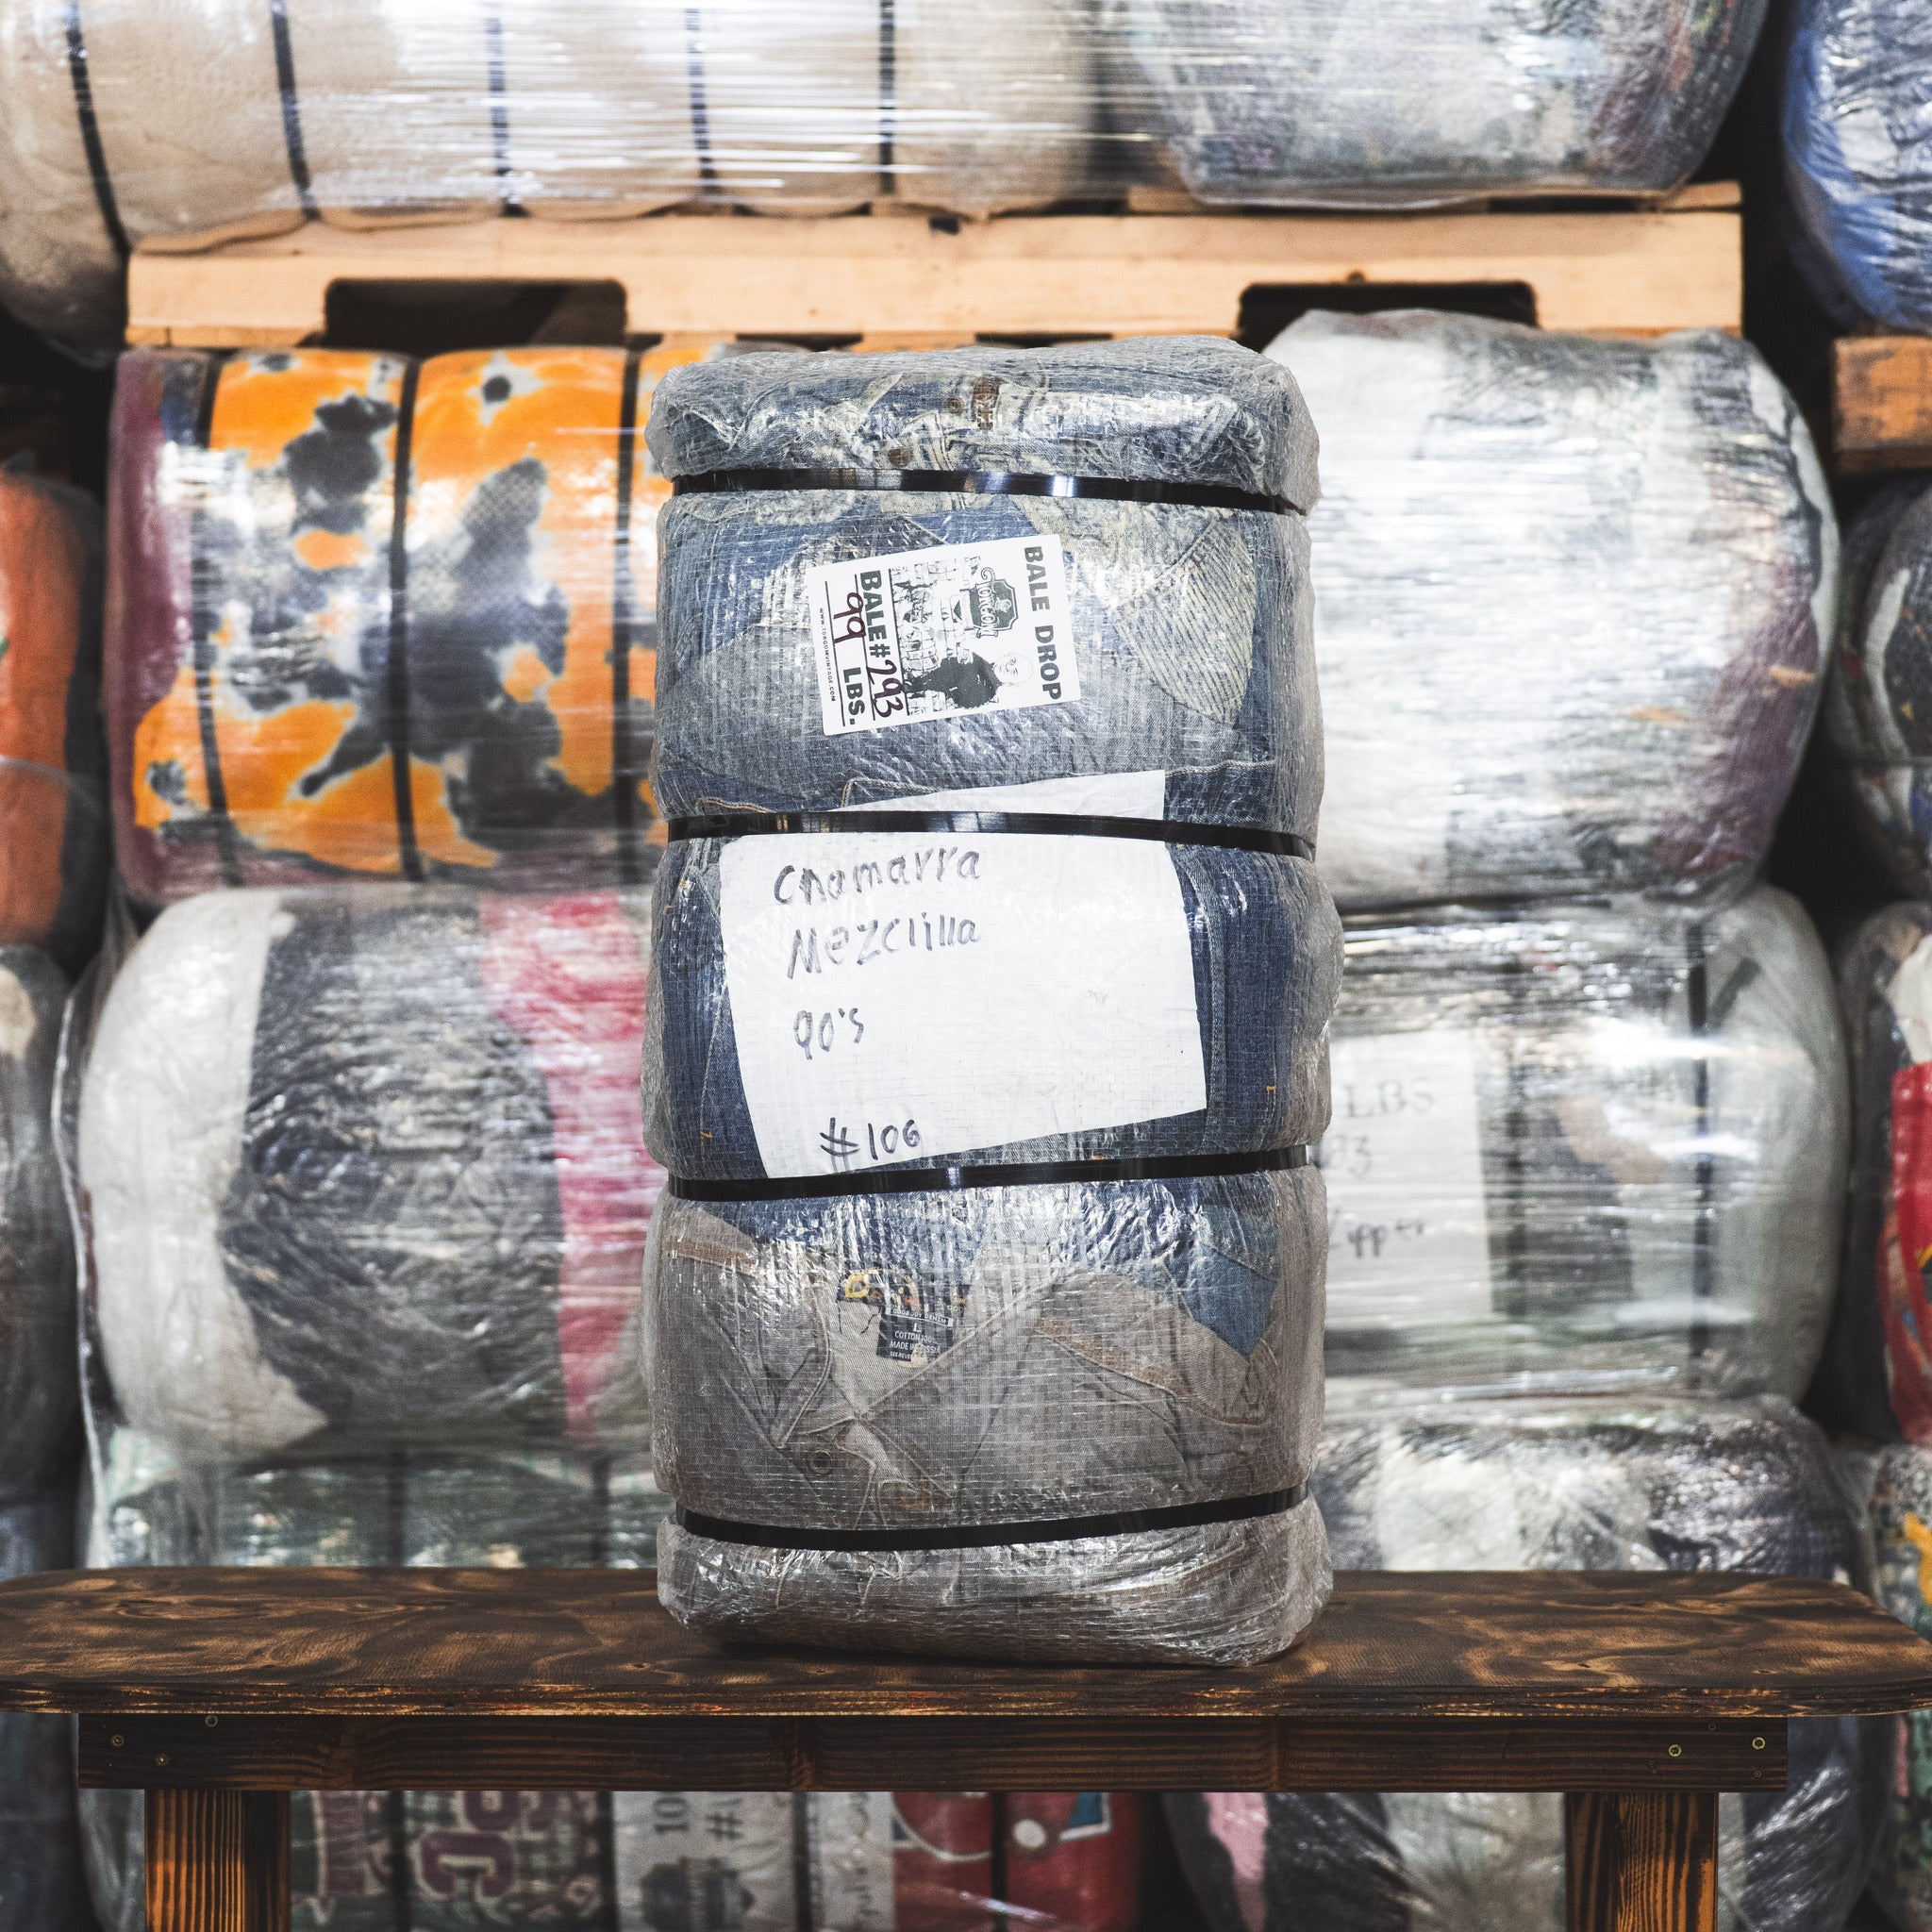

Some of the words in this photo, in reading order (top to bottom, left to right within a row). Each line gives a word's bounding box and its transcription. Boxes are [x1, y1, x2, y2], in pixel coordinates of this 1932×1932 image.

[1024, 546, 1051, 612] BALE
[833, 591, 867, 643] 99
[1035, 625, 1062, 701] DROP
[843, 667, 866, 725] LBS.
[793, 1008, 864, 1060] 90's
[1344, 1076, 1434, 1118] LBS
[820, 1117, 921, 1173] #106
[889, 1340, 909, 1351] MADE
[894, 1330, 921, 1341] COTTON
[913, 1323, 923, 1333] L
